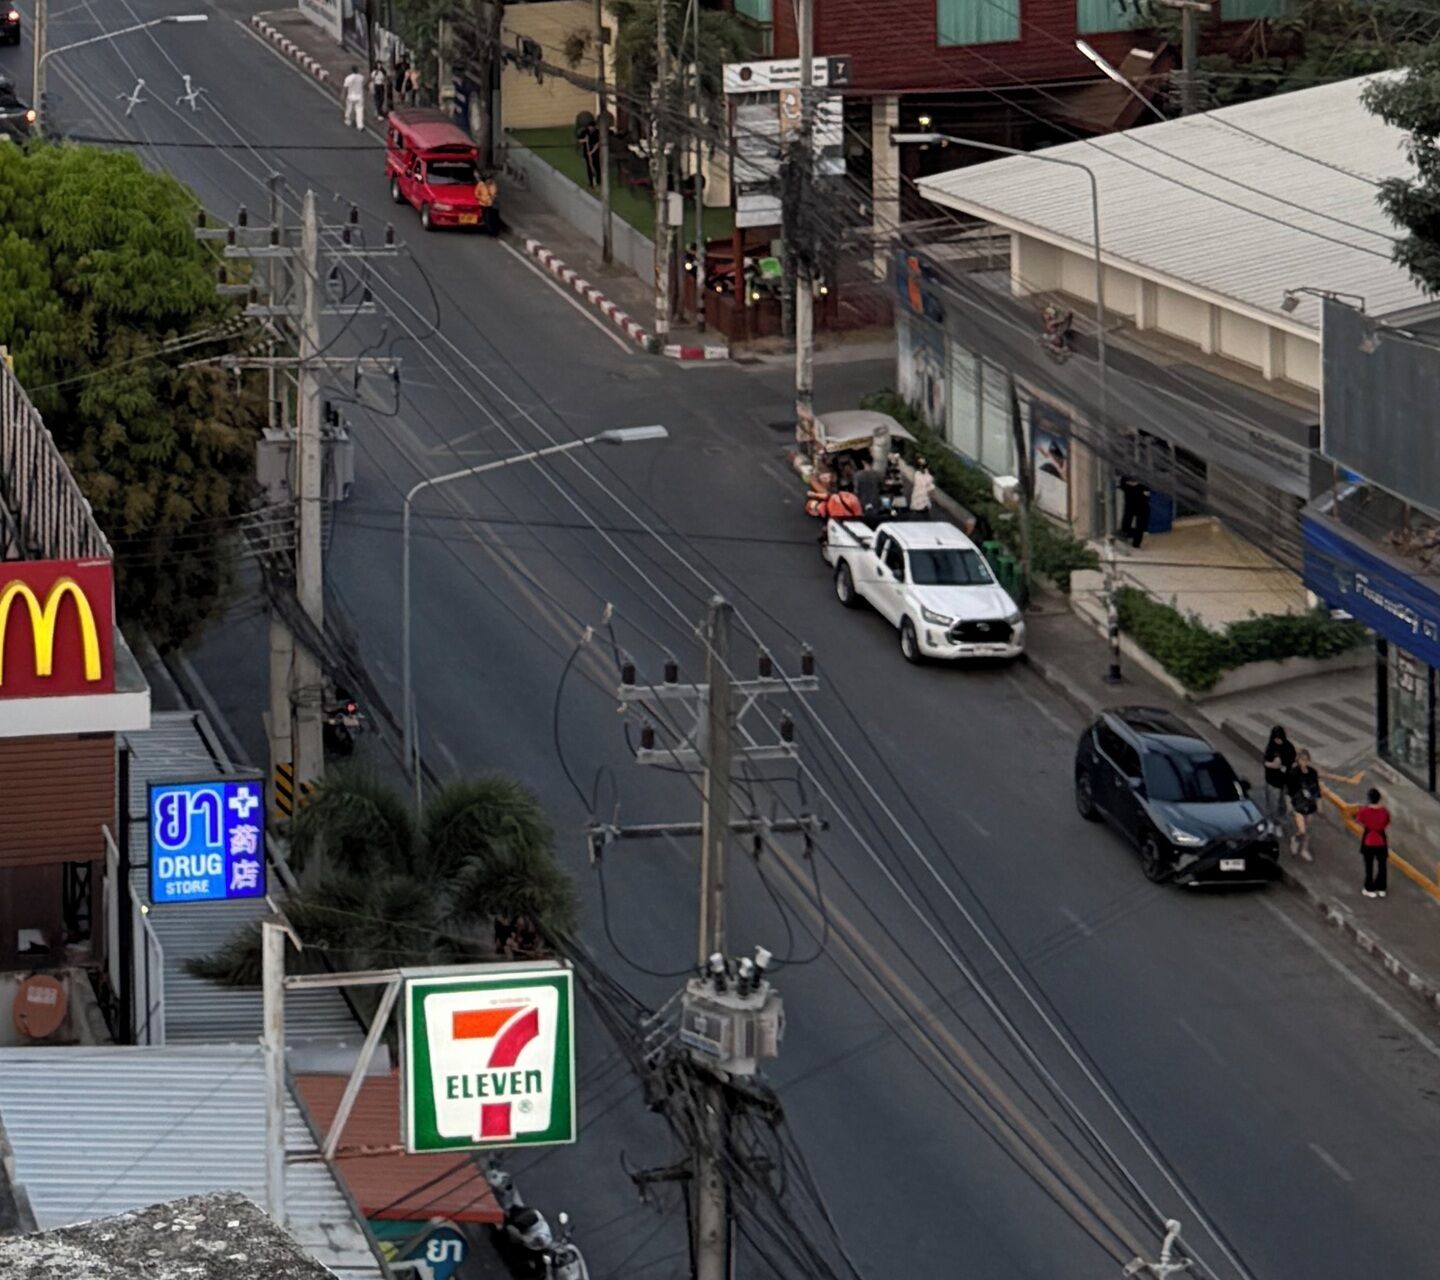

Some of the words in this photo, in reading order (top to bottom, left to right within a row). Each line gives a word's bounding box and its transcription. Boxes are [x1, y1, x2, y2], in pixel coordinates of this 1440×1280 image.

[155, 788, 223, 851] ยา
[159, 853, 222, 879] DRUG
[165, 879, 209, 895] STORE
[452, 1005, 540, 1069] 7
[426, 1239, 463, 1263] ยา
